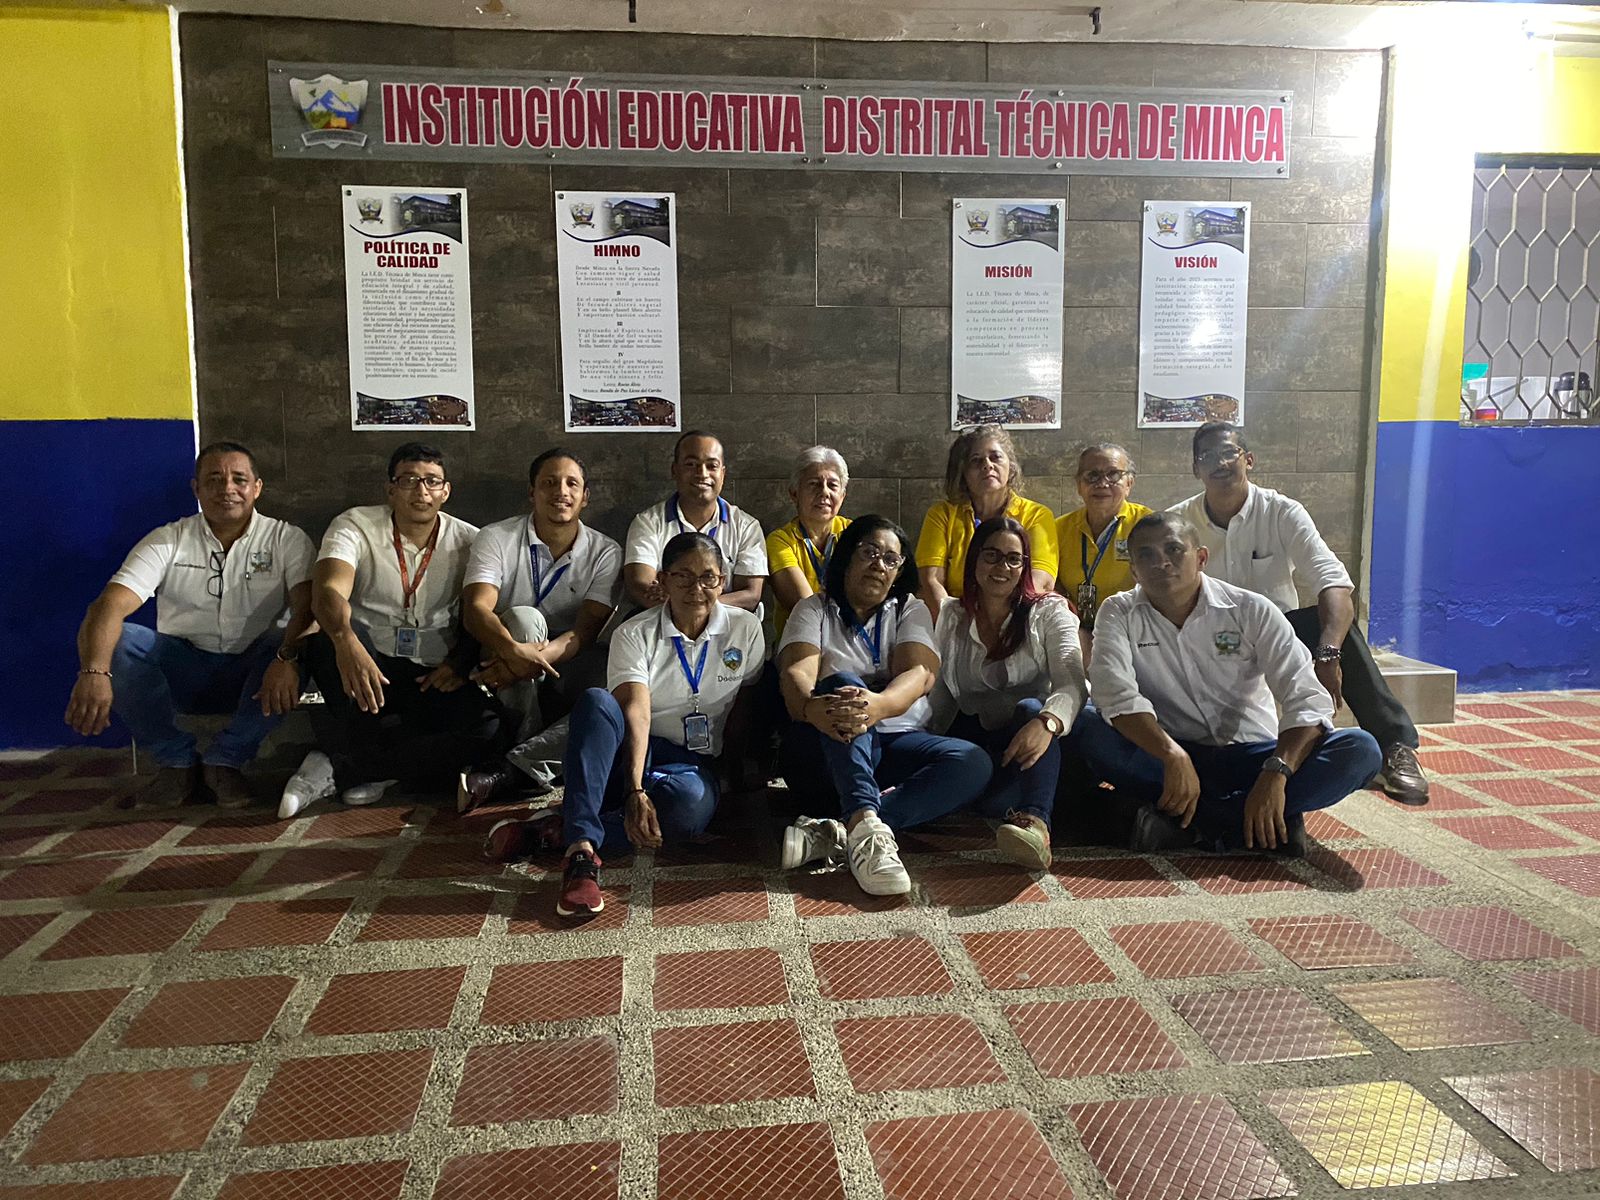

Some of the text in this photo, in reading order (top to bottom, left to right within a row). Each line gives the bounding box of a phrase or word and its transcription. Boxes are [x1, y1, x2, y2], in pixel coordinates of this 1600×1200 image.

[380, 77, 1285, 164] INSTITUCIÓN EDUCATIVA DISTRITAL TÉCNICA DE MINCA
[364, 240, 450, 254] POLÍTICA DE
[594, 244, 641, 257] HIMNO
[376, 256, 438, 268] CALIDAD
[1174, 254, 1218, 268] VISIÓN
[985, 264, 1033, 278] MISIÓN
